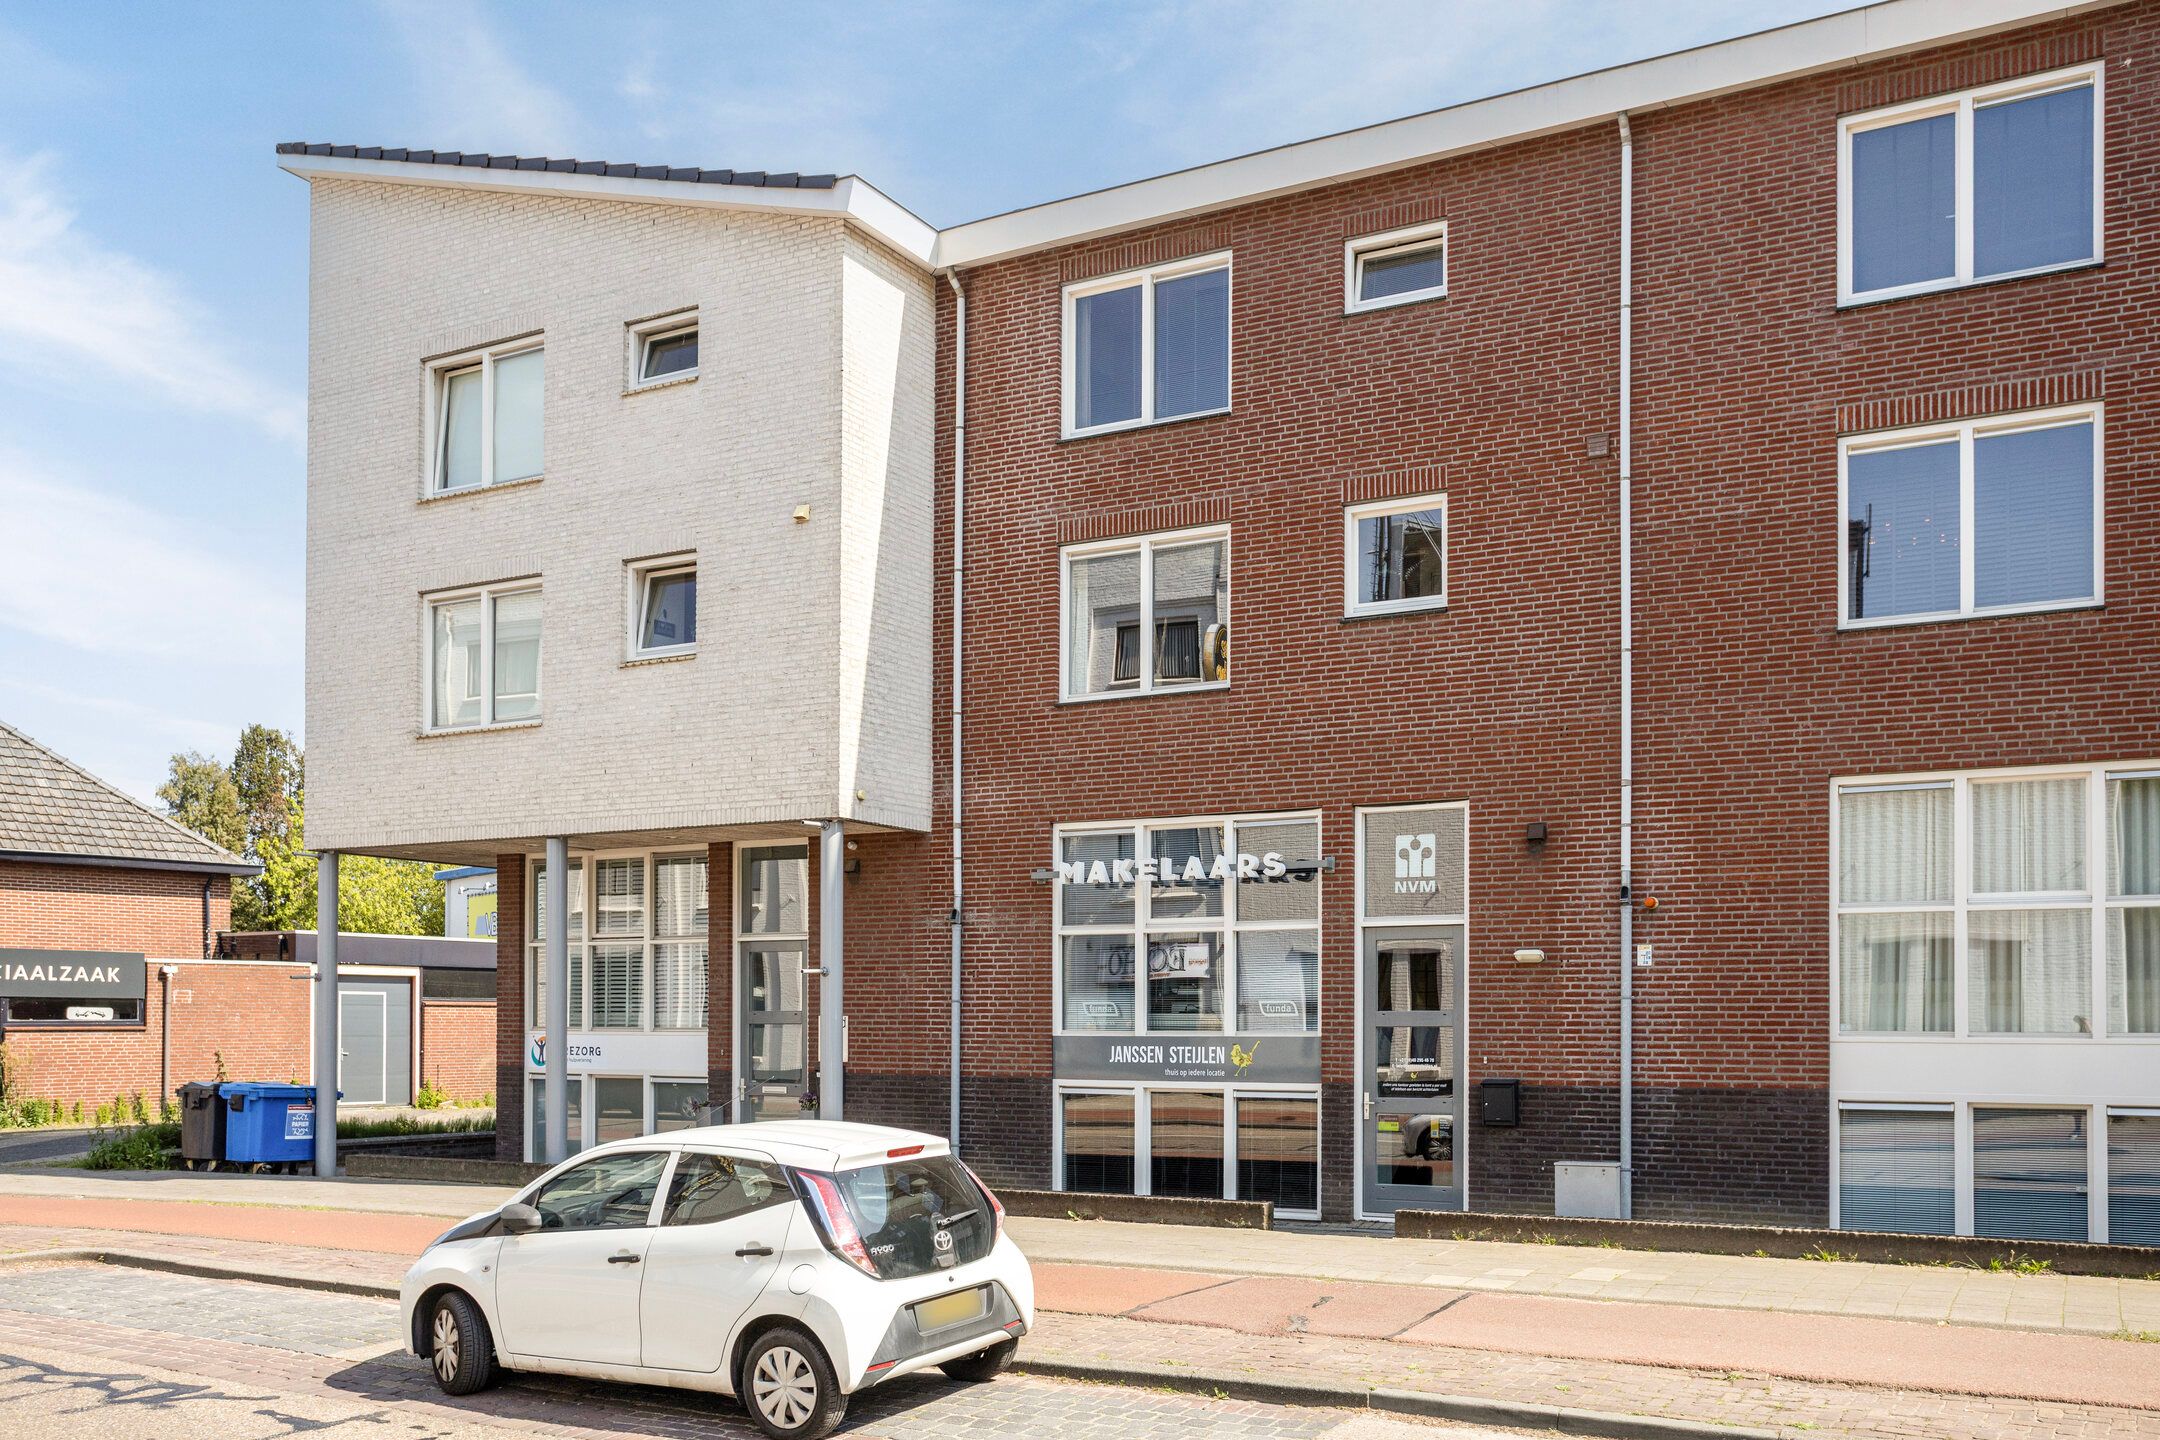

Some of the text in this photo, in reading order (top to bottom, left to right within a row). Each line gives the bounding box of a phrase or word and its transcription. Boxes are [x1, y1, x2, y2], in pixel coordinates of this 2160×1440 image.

[1059, 852, 1287, 885] MAKELAARS
[1394, 880, 1436, 893] NVM
[0, 964, 120, 982] IAALZAAK
[1265, 1003, 1292, 1013] funda
[566, 1046, 601, 1056] EZORG
[1109, 1045, 1225, 1064] JANSSEN STEIJLEN
[1164, 1068, 1179, 1076] thuis
[1188, 1068, 1205, 1076] iedere
[1206, 1068, 1225, 1076] locatie
